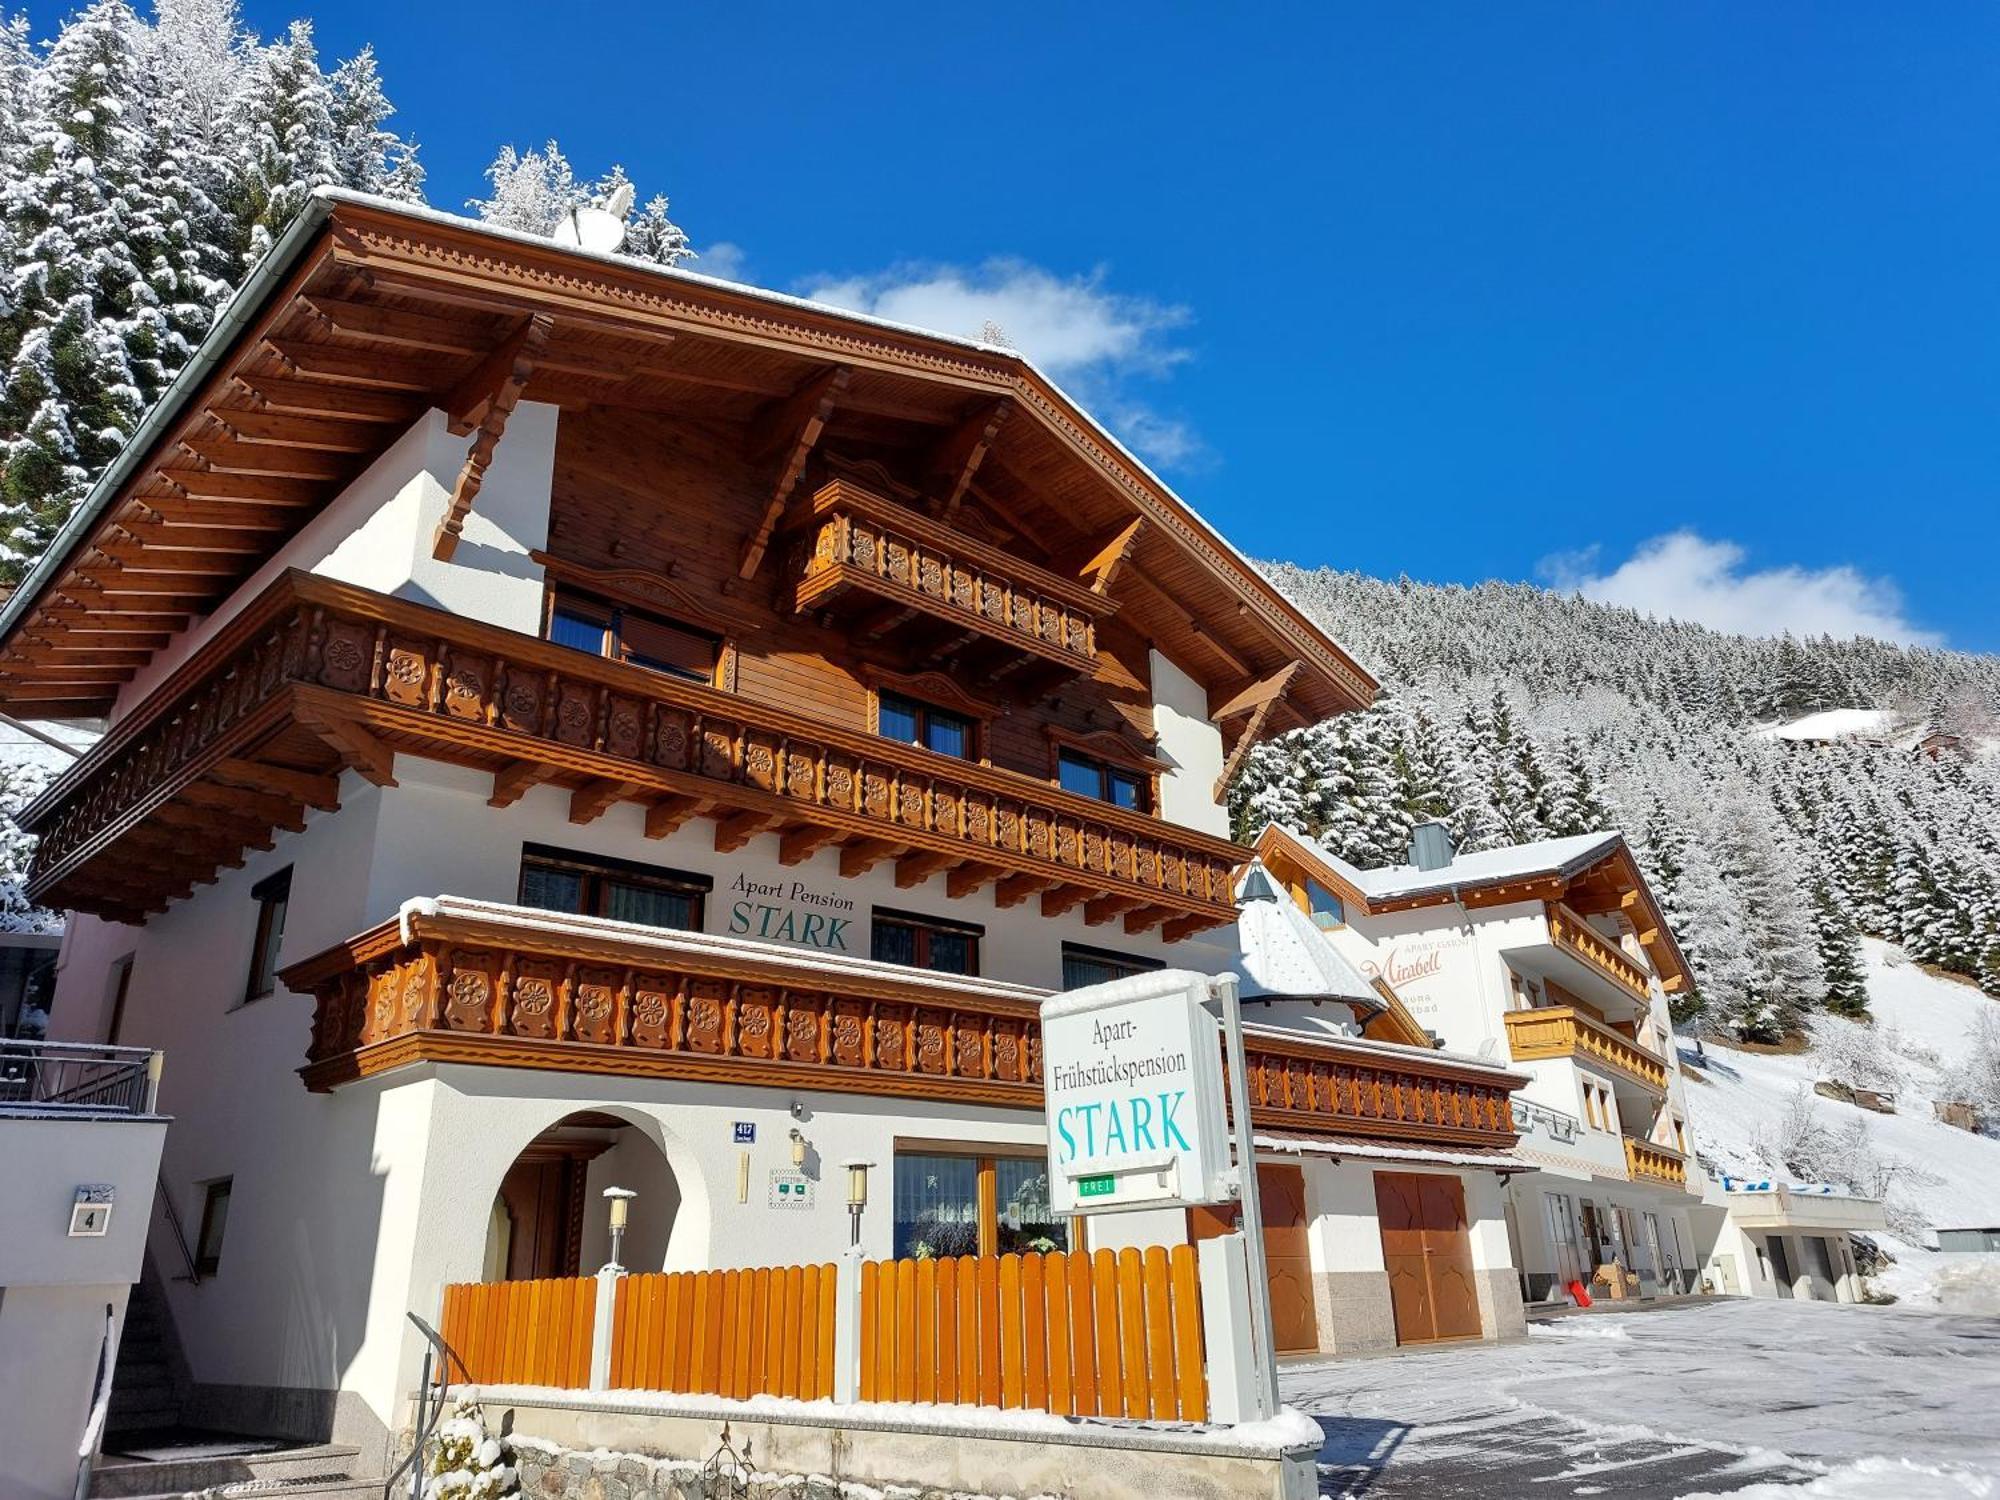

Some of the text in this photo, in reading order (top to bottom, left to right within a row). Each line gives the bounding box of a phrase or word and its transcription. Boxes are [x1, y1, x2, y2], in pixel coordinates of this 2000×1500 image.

[731, 872, 854, 911] Apart Pension
[727, 901, 853, 950] STARK
[1360, 948, 1442, 984] Mirabell
[1402, 993, 1432, 1004] auna
[1092, 1018, 1138, 1050] Apart-
[1053, 1047, 1187, 1092] Frühstückspension
[1058, 1090, 1192, 1165] STARK
[1083, 1179, 1111, 1194] FREI
[85, 1212, 95, 1229] 4
